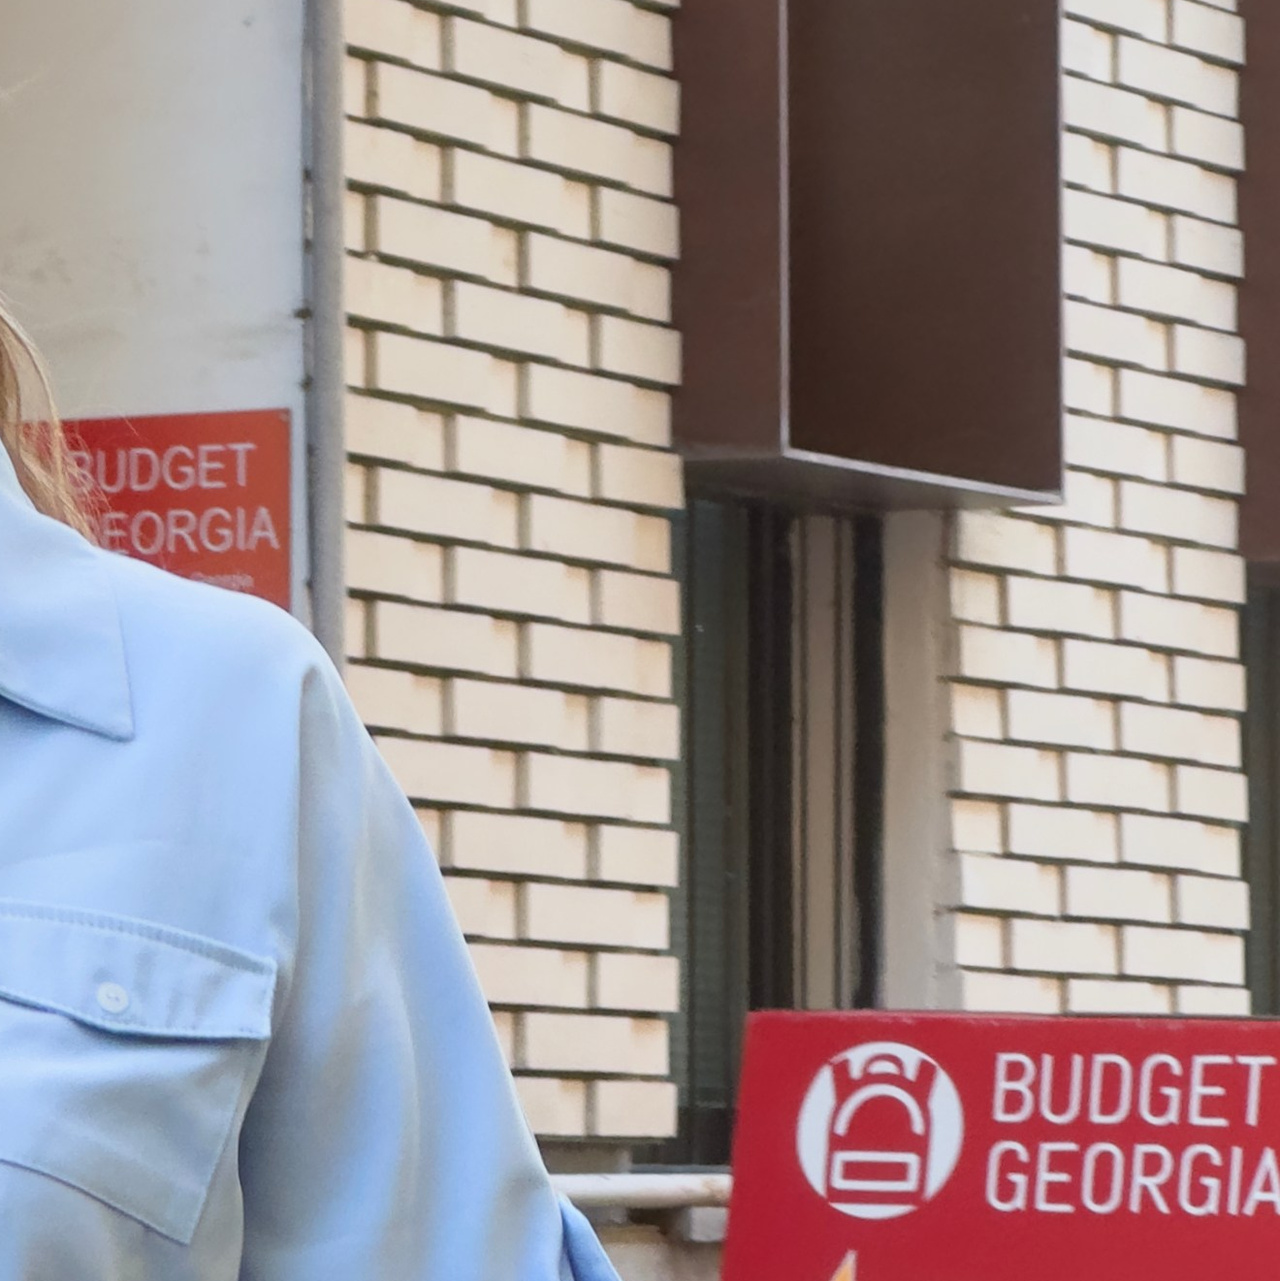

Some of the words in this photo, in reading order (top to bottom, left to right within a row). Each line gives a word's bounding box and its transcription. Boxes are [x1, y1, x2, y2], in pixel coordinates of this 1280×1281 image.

[82, 506, 281, 555] EORGIA
[994, 1053, 1276, 1127] BUDGET
[987, 1141, 1280, 1216] GEORGIA
